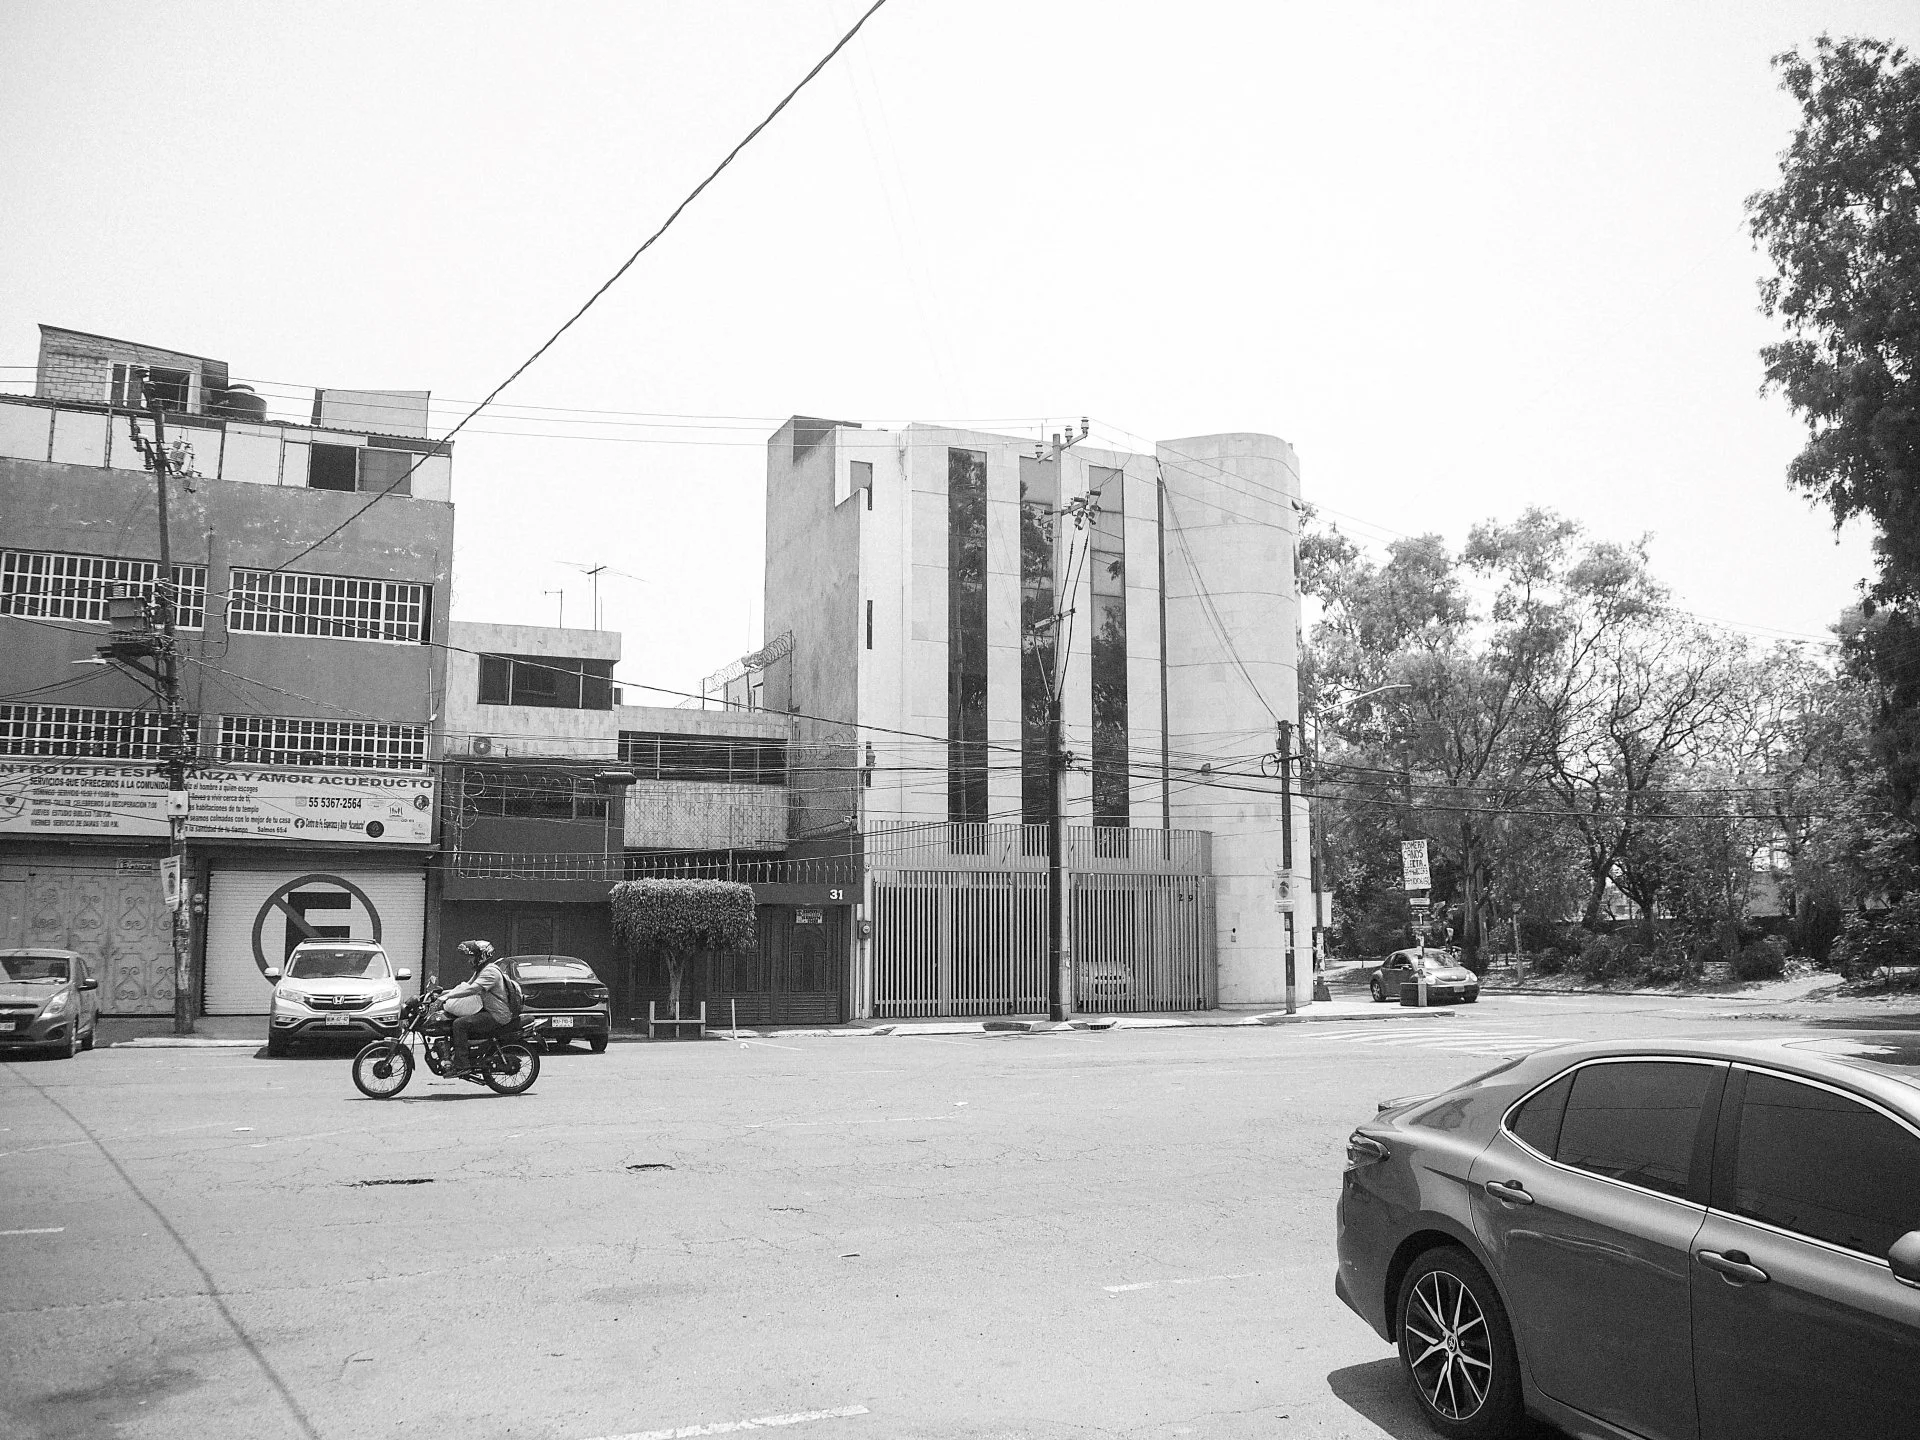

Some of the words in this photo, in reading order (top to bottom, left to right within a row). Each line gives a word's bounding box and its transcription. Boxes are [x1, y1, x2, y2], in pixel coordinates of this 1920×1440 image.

[61, 766, 88, 776] DE
[93, 767, 116, 777] FE
[121, 768, 237, 780] ESPEANZA
[241, 772, 253, 781] Y
[257, 773, 313, 784] AMOR
[319, 776, 433, 789] ACUEDUCTO
[66, 779, 79, 787] QUE
[81, 780, 119, 788] OFRECEMOS
[120, 781, 126, 789] A
[126, 781, 136, 789] LA
[136, 781, 169, 790] COMUNIDA
[199, 783, 218, 791] hombre
[237, 786, 258, 794] escoges
[308, 797, 319, 808] 55
[320, 797, 362, 809] 5367-2564
[228, 805, 235, 813] de
[234, 816, 244, 824] con
[265, 816, 272, 824] de
[279, 817, 291, 825] casa
[257, 826, 276, 834] Salmos
[829, 890, 843, 900] 31
